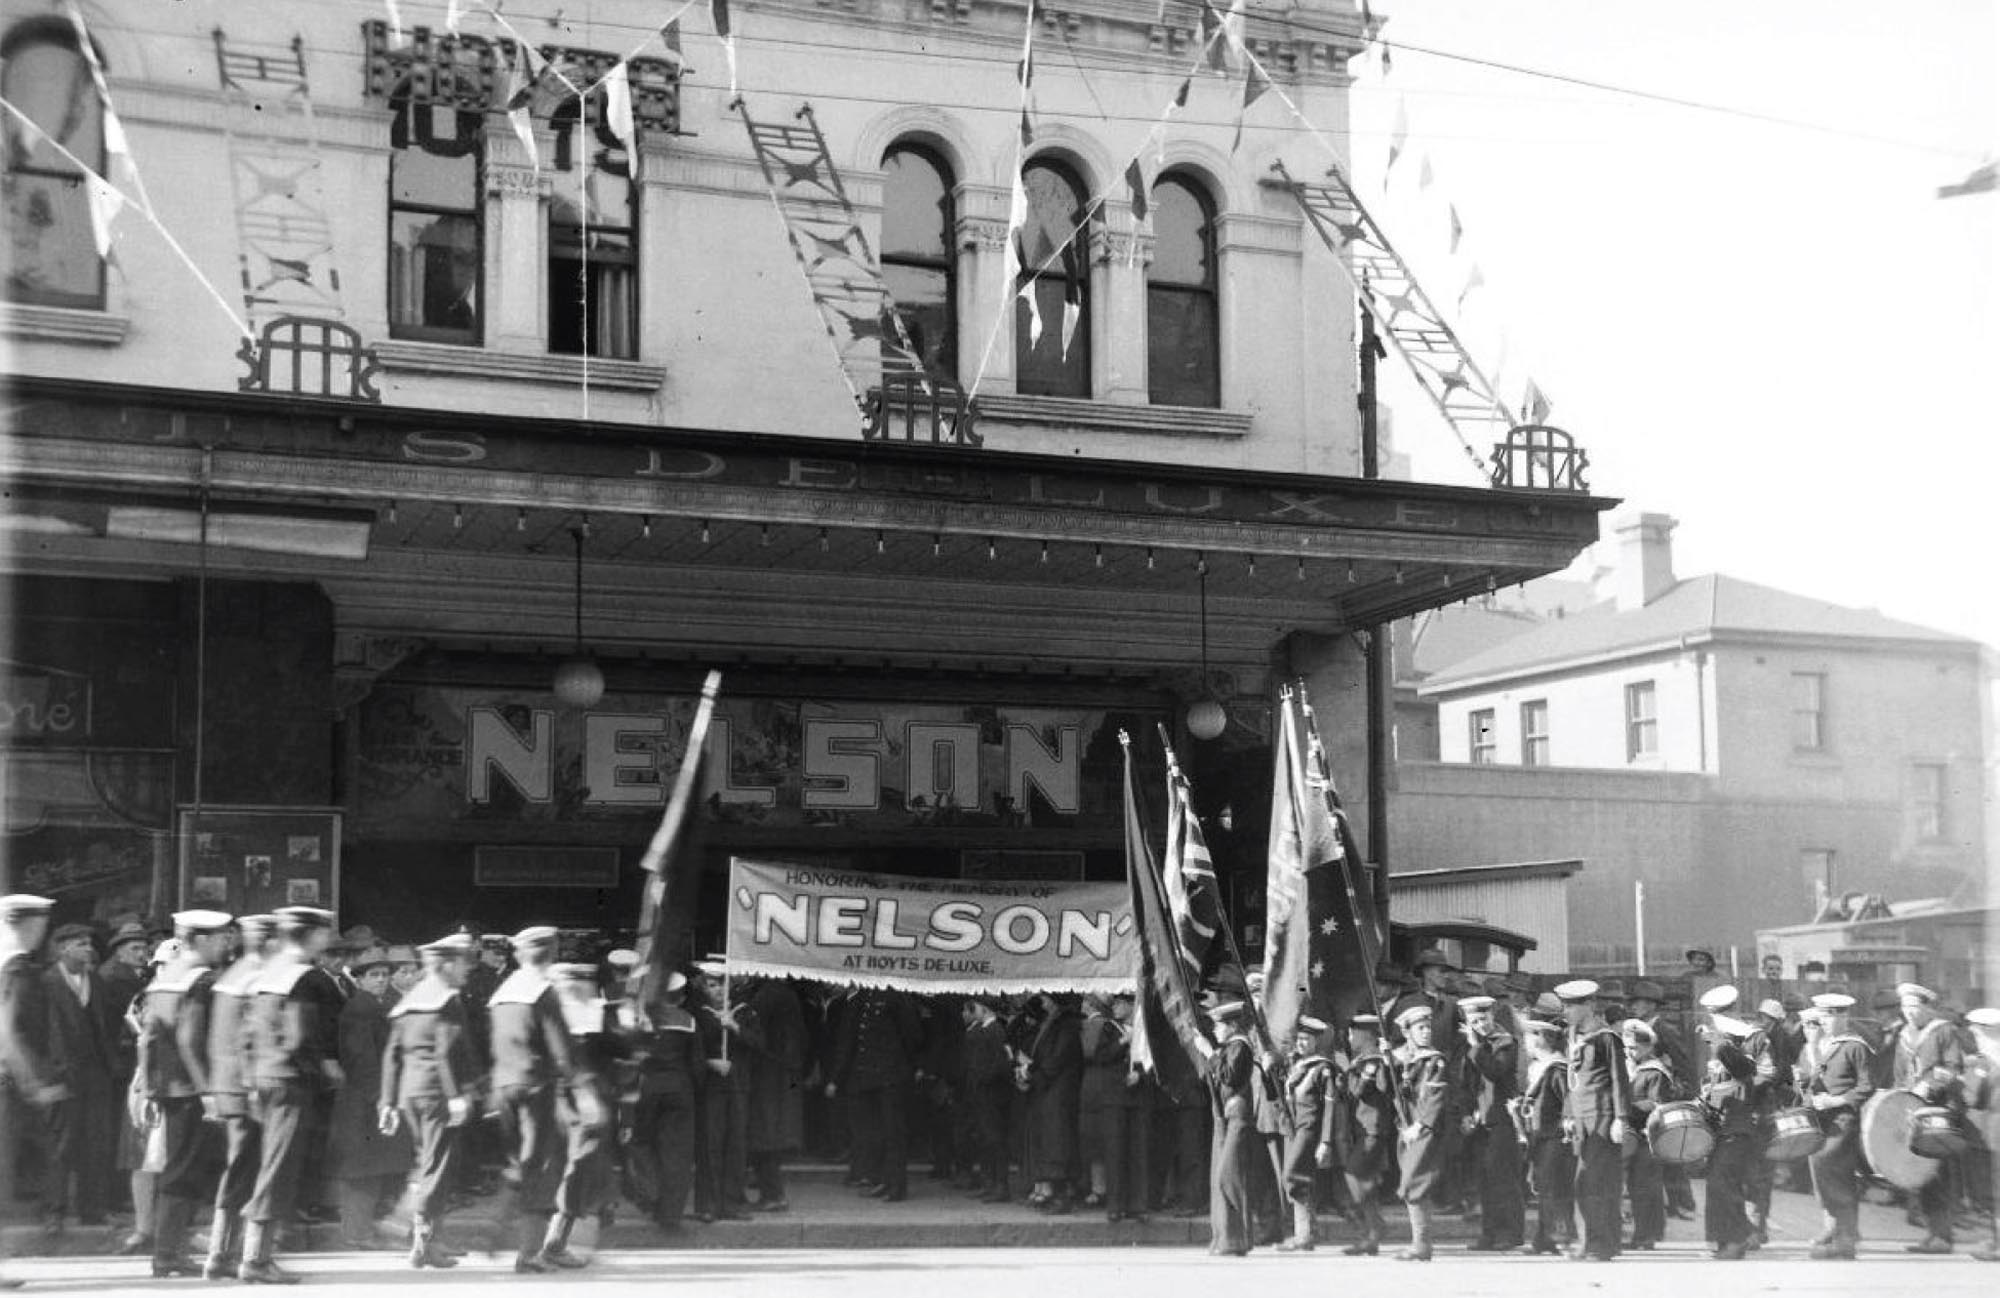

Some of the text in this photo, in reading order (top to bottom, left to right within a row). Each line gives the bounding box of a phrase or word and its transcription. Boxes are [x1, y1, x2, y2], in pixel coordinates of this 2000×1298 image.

[467, 705, 1081, 814] NELSON
[786, 870, 1059, 899] HONORING THE MEMORY OF
[843, 954, 863, 969] AT
[867, 955, 919, 971] HOYTS
